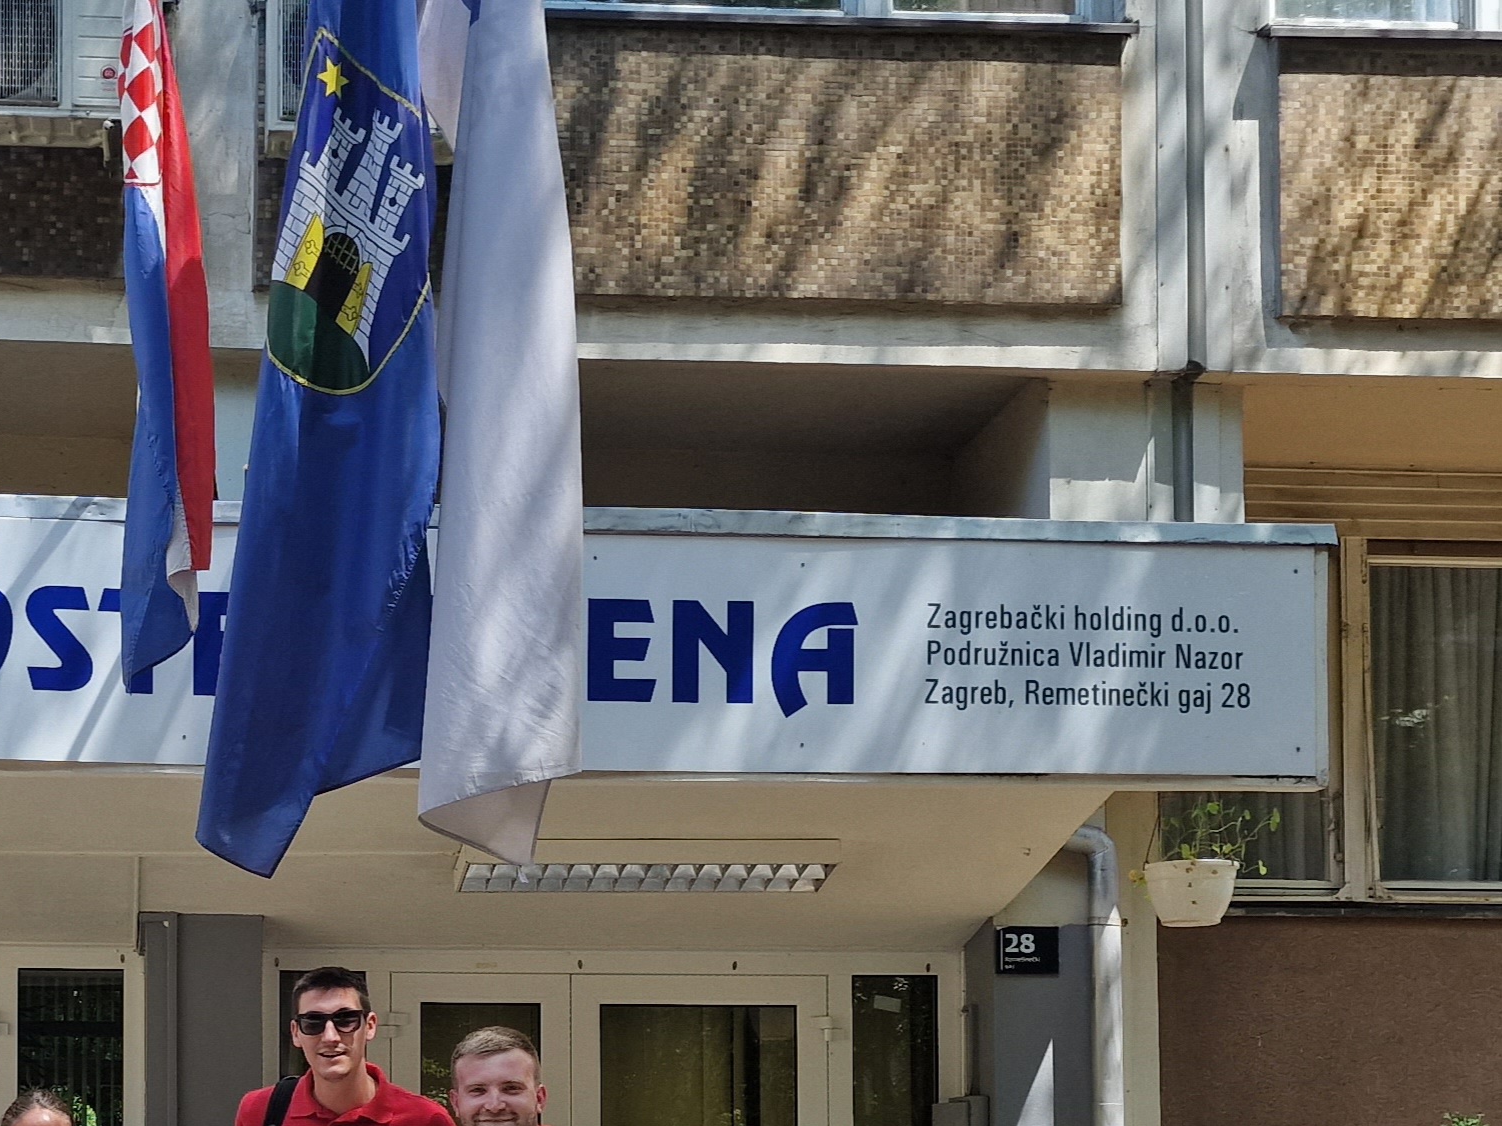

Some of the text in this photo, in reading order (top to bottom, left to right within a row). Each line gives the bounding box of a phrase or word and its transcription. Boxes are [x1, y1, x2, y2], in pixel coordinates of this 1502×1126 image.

[926, 603, 1239, 638] Zagrebački holding d.o.o.
[587, 597, 858, 718] ENA
[926, 640, 1244, 670] Podružnica Vladimir Nazor
[925, 678, 1251, 714] Zagreb, Remetinečki gaj 28
[1005, 933, 1036, 954] 28
